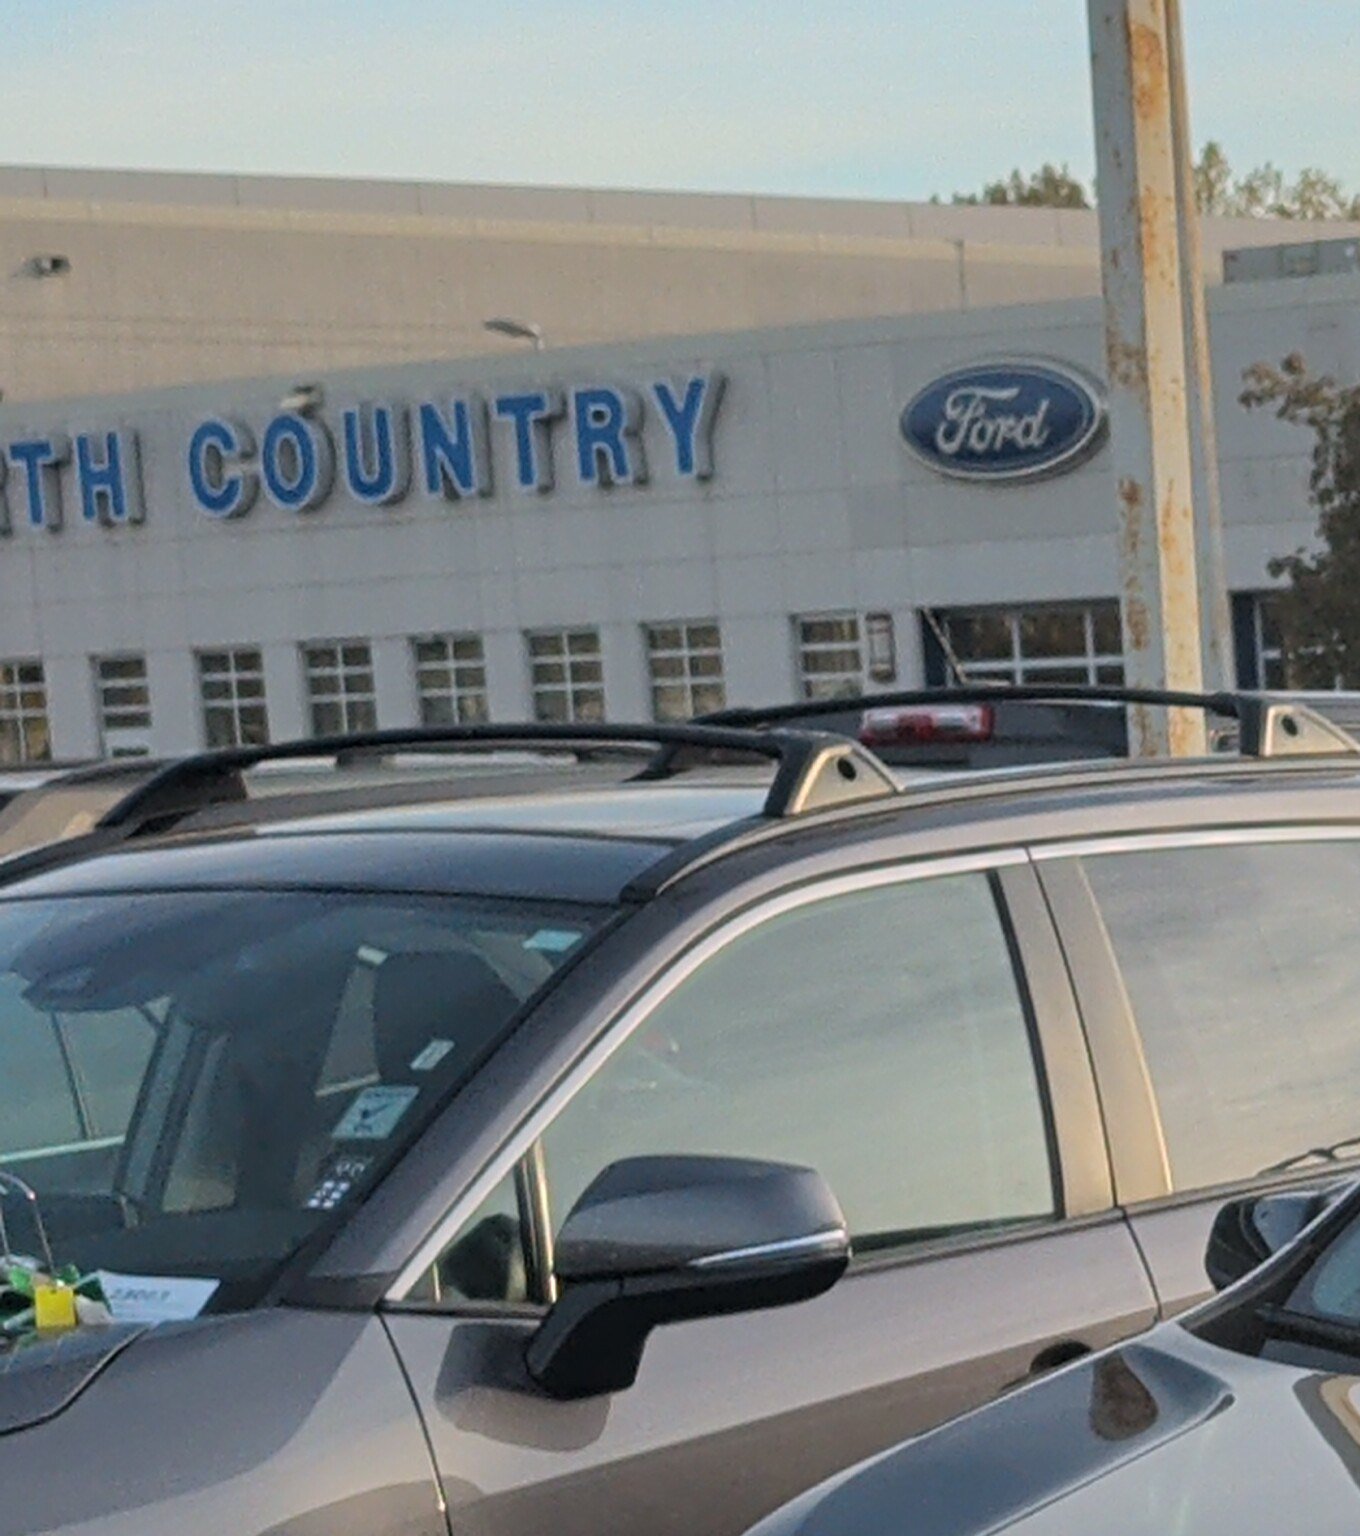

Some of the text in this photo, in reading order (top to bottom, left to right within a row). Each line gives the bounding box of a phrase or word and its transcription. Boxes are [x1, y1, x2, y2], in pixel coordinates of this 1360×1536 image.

[0, 373, 714, 532] TH COUNTRY
[936, 385, 1050, 455] Ford
